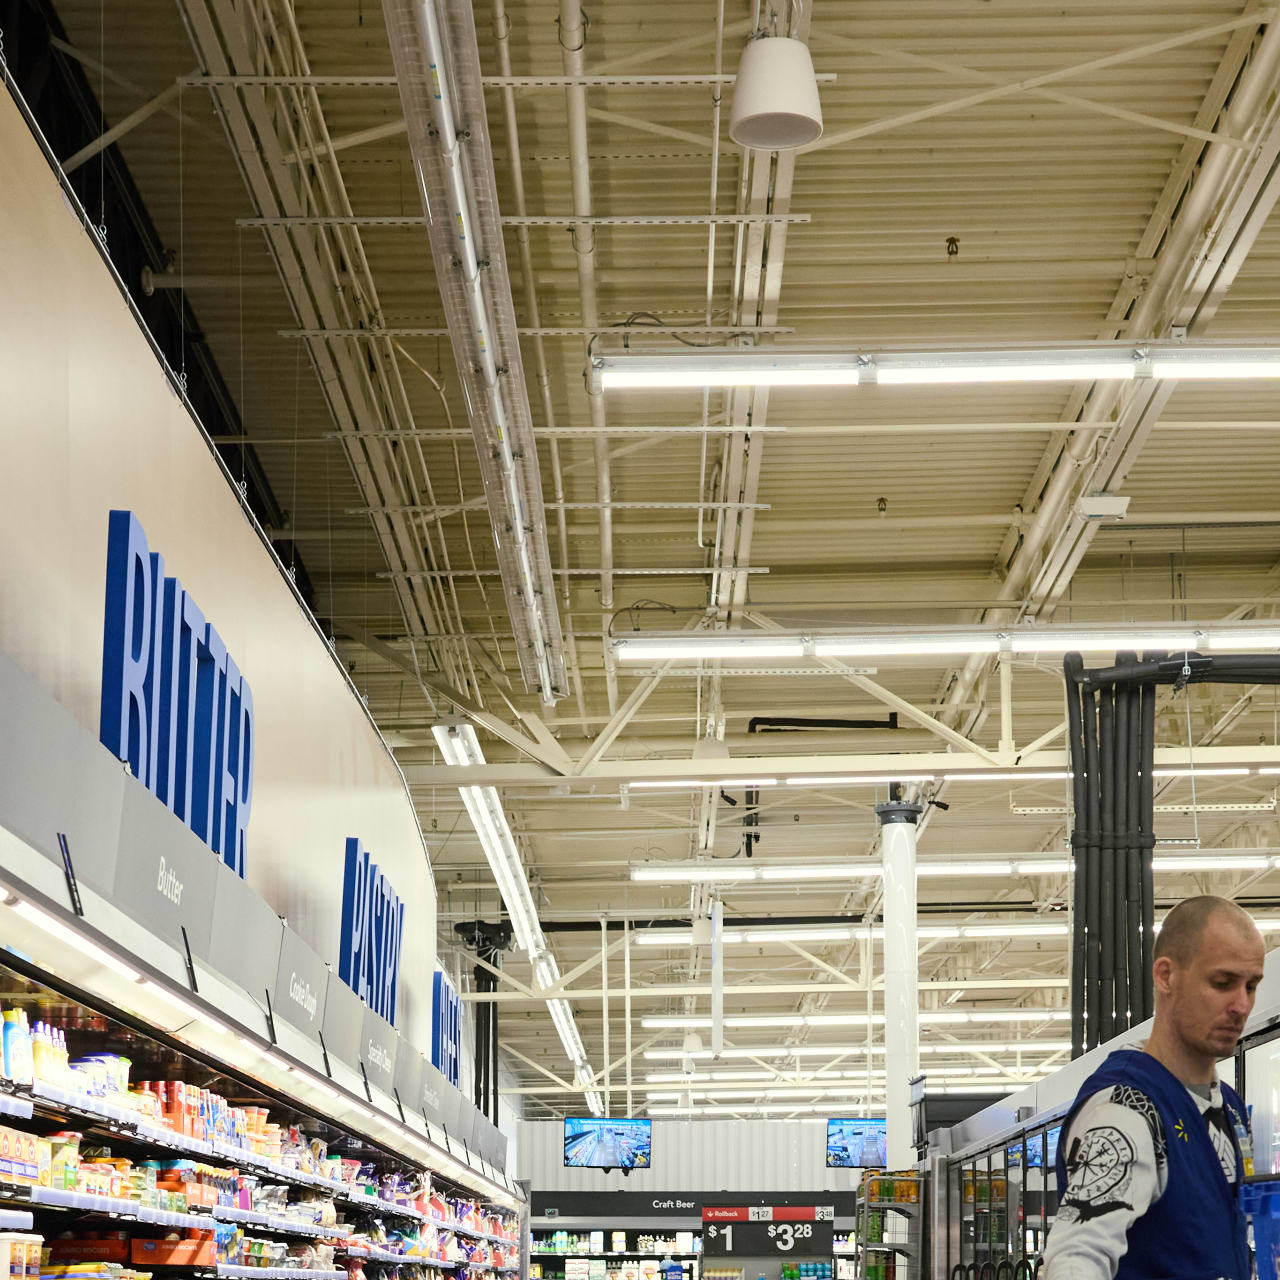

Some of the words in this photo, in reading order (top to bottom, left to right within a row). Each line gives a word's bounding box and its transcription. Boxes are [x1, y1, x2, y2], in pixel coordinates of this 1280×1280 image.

[100, 510, 255, 880] BUTTER
[157, 856, 184, 905] Butter
[338, 837, 405, 1027] PASTRY
[653, 1200, 674, 1209] Craft
[676, 1200, 695, 1209] Beer
